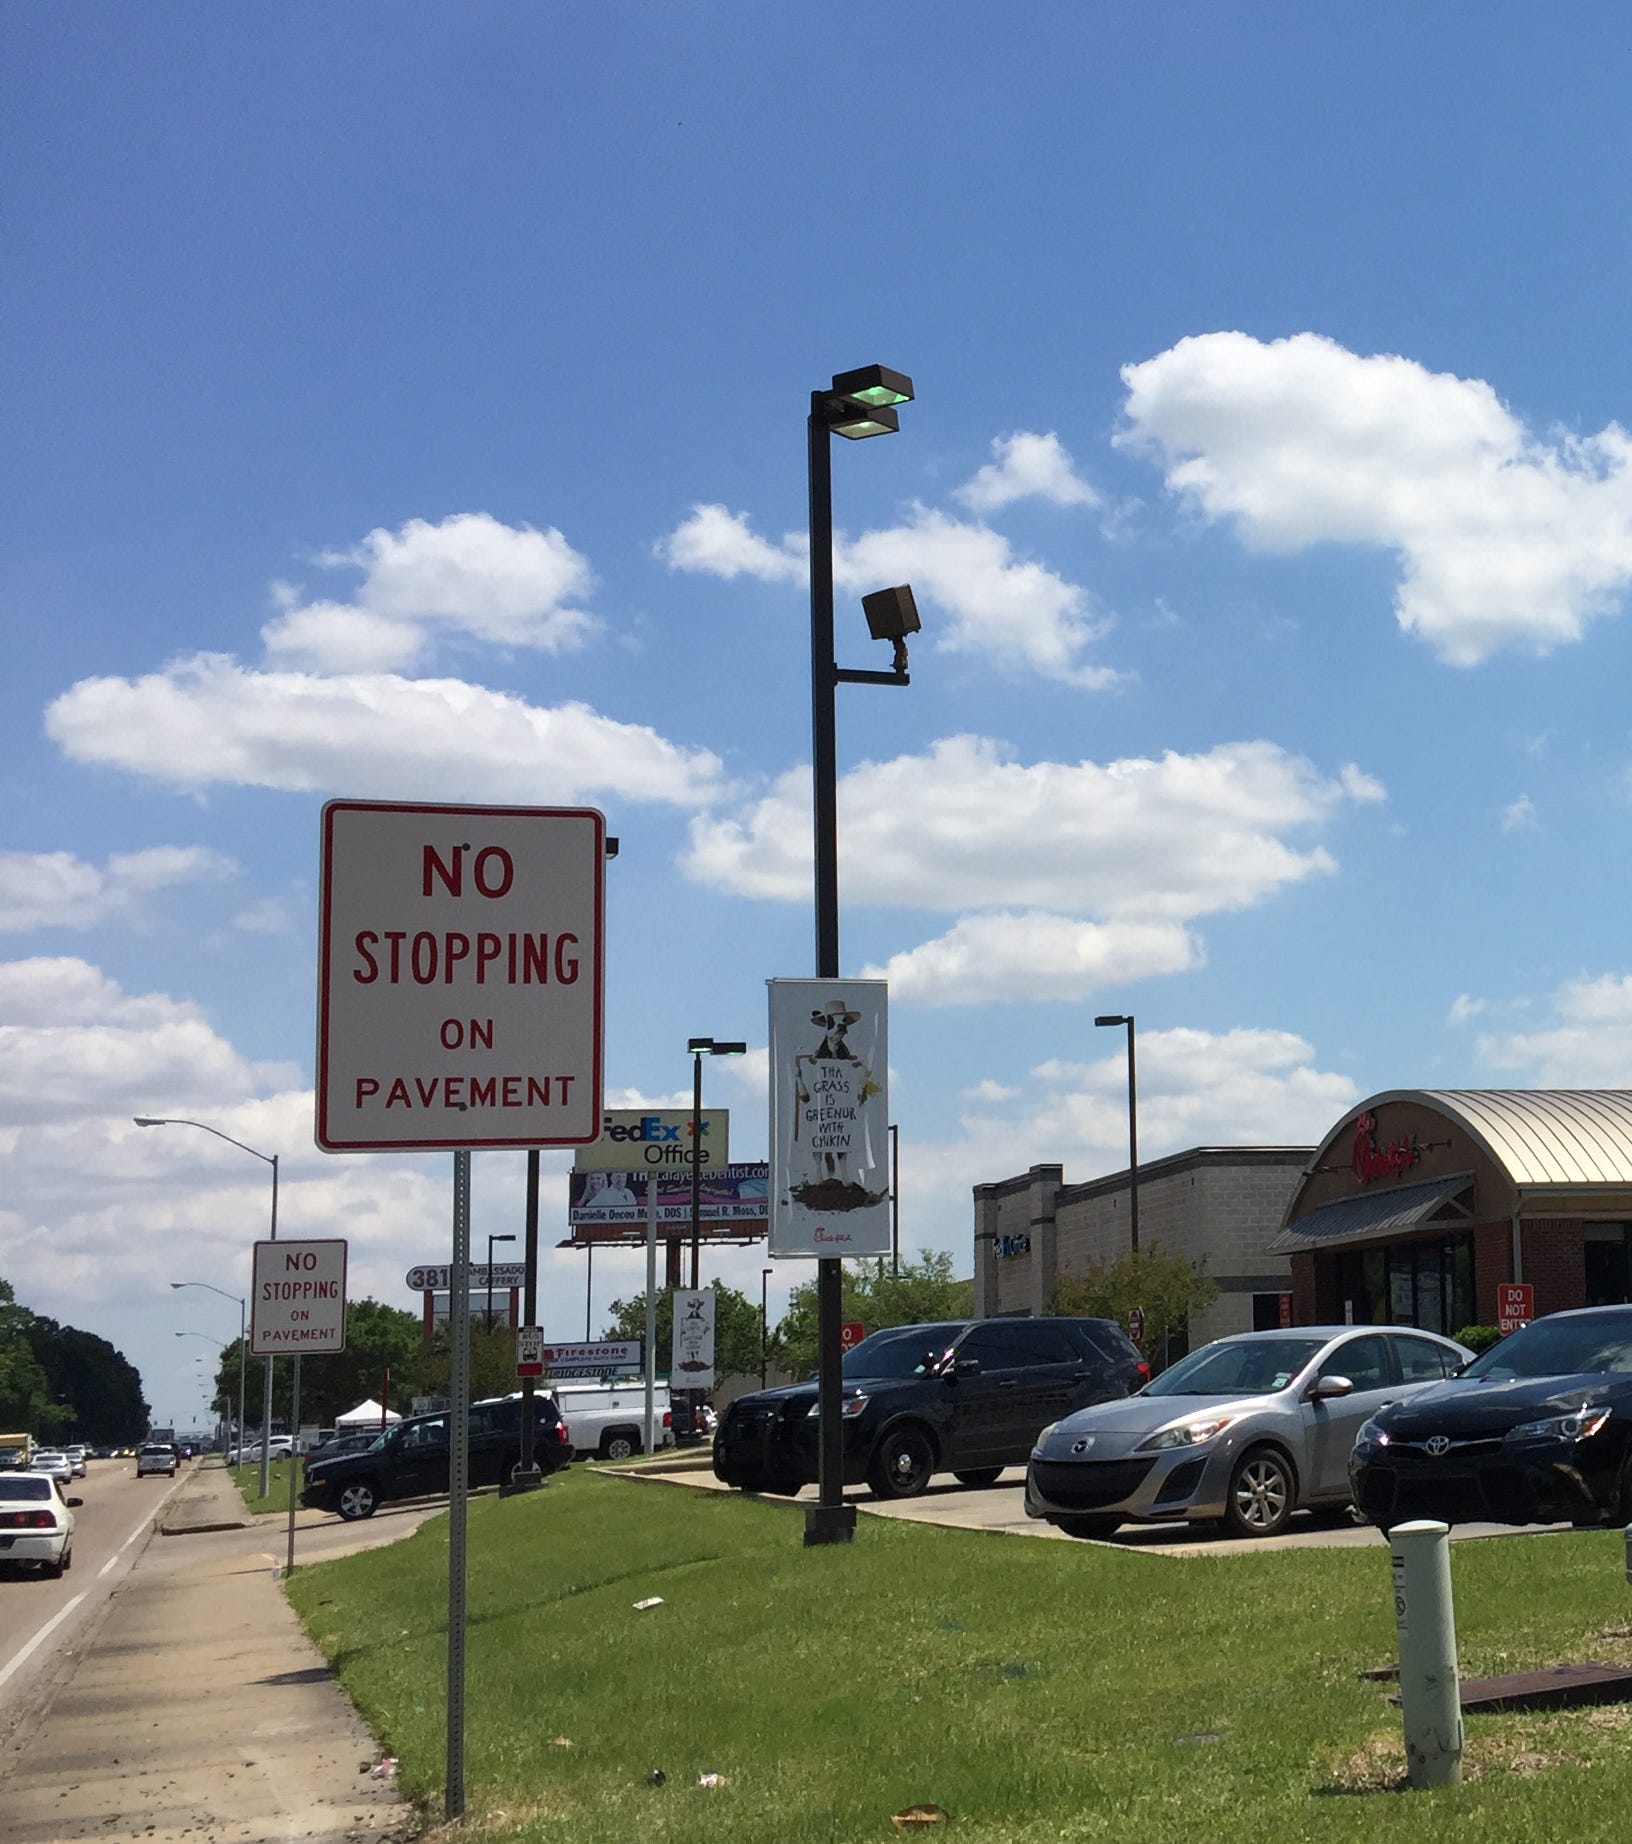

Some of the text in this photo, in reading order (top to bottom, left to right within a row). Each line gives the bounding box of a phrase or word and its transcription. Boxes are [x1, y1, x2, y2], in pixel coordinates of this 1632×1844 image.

[422, 845, 514, 899] NO
[353, 931, 579, 986] STOPPING
[440, 1019, 493, 1050] ON
[821, 1066, 843, 1079] THA
[356, 1076, 575, 1109] PAVEMENT
[813, 1080, 850, 1094] GRASS
[825, 1094, 835, 1106] IS
[805, 1107, 857, 1121] GREENUR
[818, 1121, 844, 1134] WITH
[812, 1134, 851, 1148] CHIKIN
[644, 1144, 710, 1164] Office
[286, 1253, 317, 1271] NO
[413, 1269, 448, 1288] 381
[262, 1281, 338, 1300] STOPPING
[1508, 1289, 1523, 1302] DO
[290, 1310, 310, 1321] ON
[1505, 1304, 1526, 1316] NOT
[262, 1328, 336, 1341] PAVEMENT
[555, 1346, 629, 1358] Firestone
